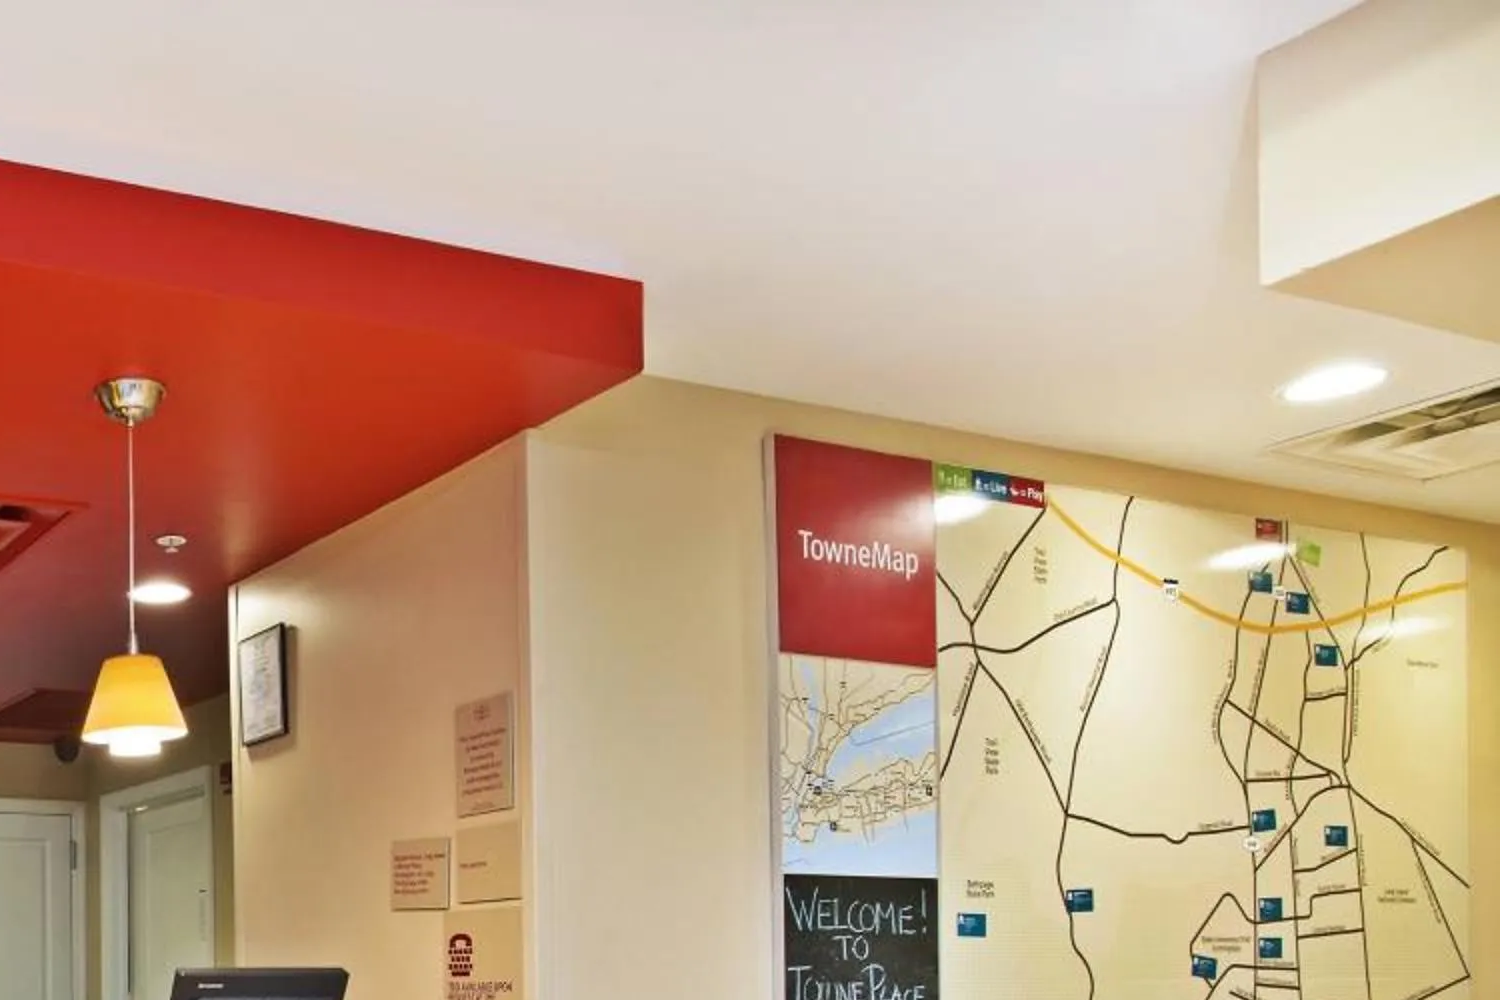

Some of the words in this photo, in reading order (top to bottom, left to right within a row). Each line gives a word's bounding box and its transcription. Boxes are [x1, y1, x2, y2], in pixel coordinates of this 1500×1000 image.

[798, 529, 919, 581] TowneMap
[785, 886, 928, 935] WELCOME!
[831, 935, 869, 960] TO
